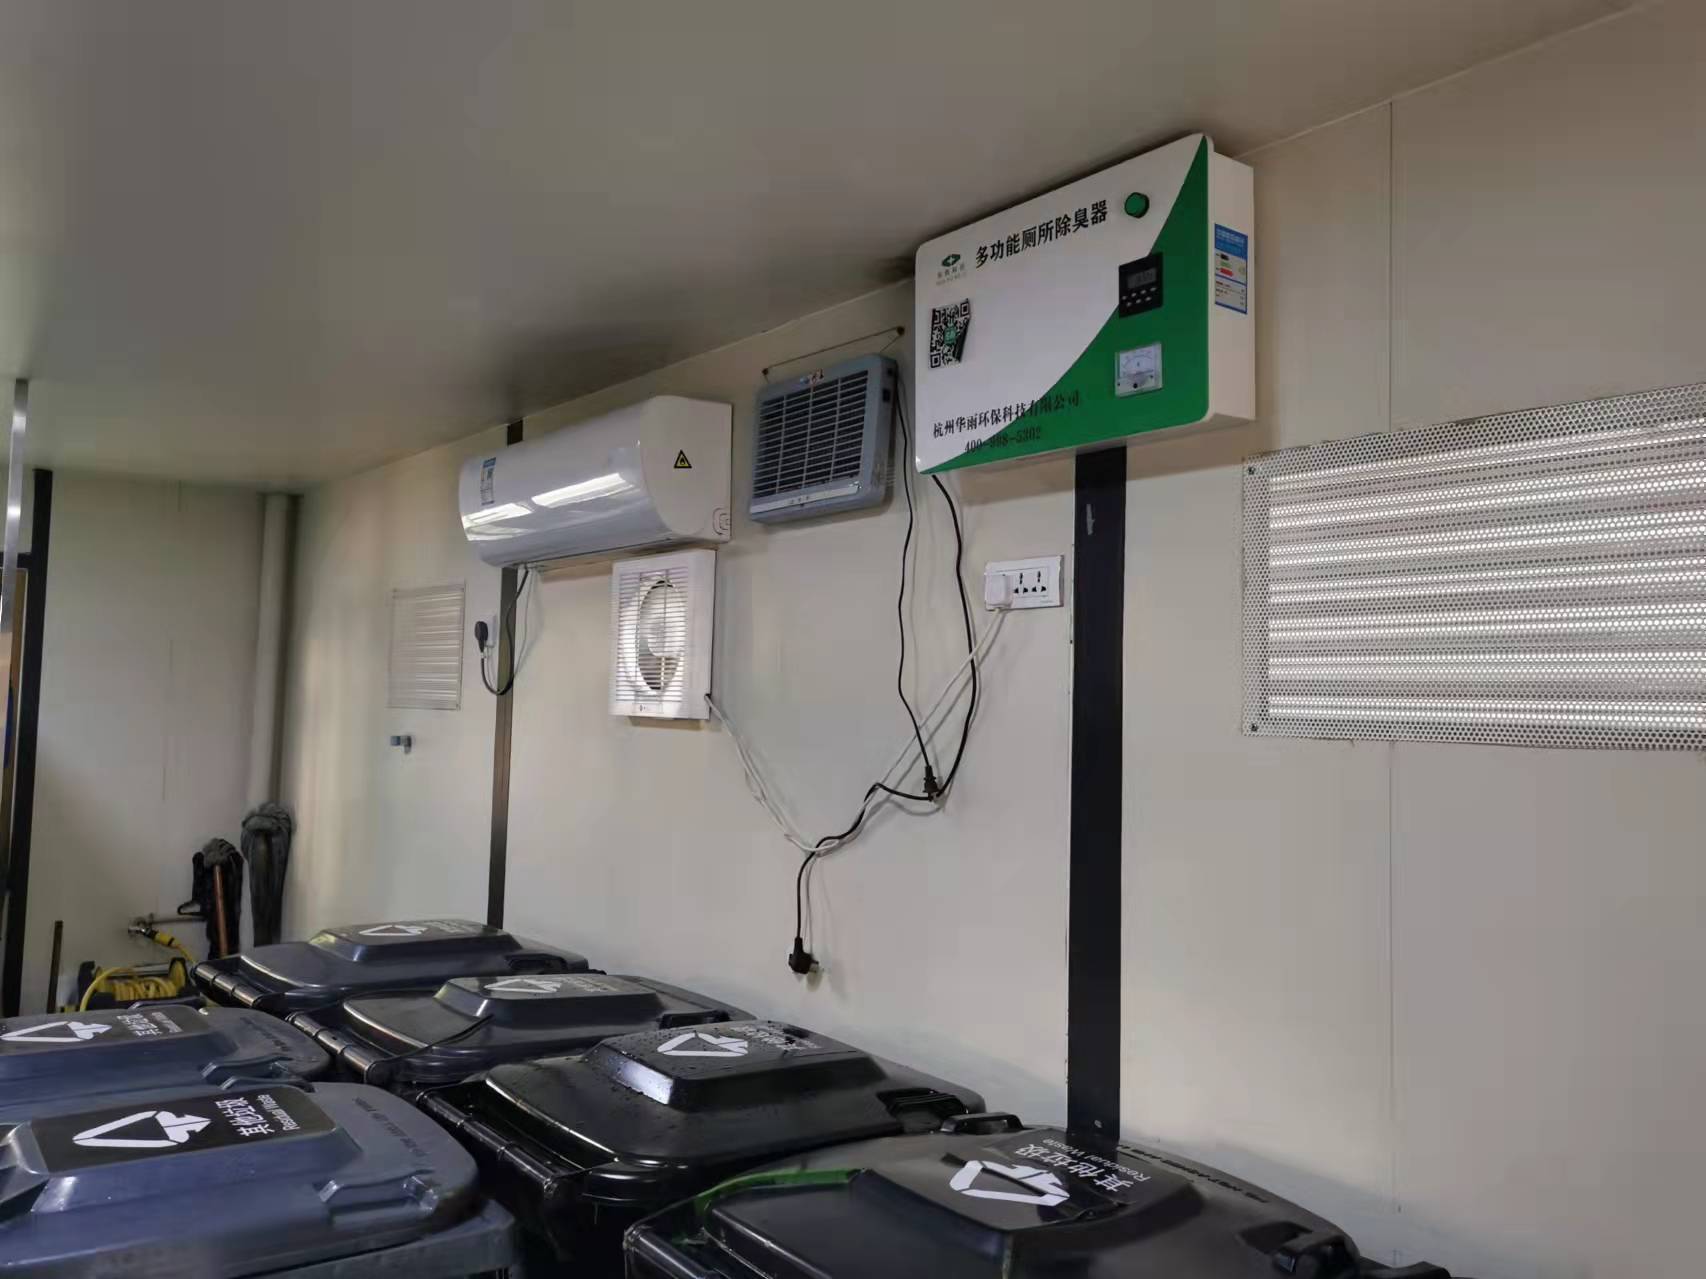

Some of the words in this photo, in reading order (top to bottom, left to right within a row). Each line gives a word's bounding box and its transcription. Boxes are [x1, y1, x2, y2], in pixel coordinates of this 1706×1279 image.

[975, 200, 1107, 268] 多功能厕所除臭器
[1015, 1144, 1133, 1192] 其他垃圾
[1086, 1156, 1151, 1182] Residual
